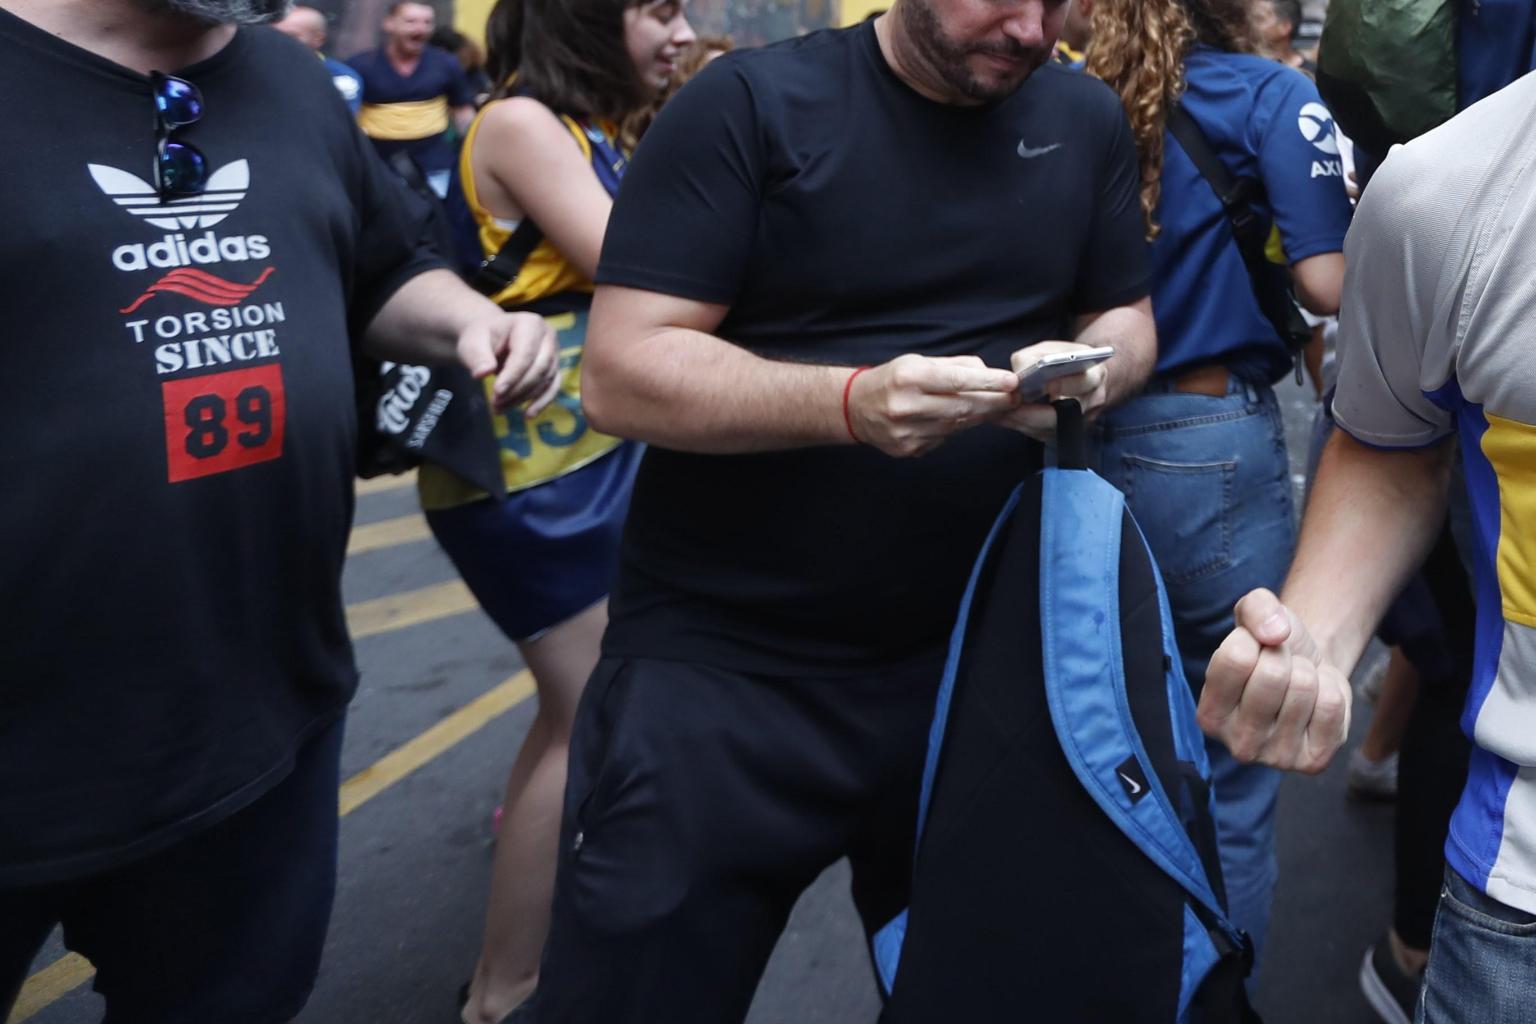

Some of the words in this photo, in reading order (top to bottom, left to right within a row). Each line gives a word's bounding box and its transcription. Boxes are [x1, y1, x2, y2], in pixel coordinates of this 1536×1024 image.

[112, 231, 271, 272] adidas
[125, 301, 286, 343] TORSION
[154, 328, 280, 374] SINCE
[184, 384, 273, 460] 89
